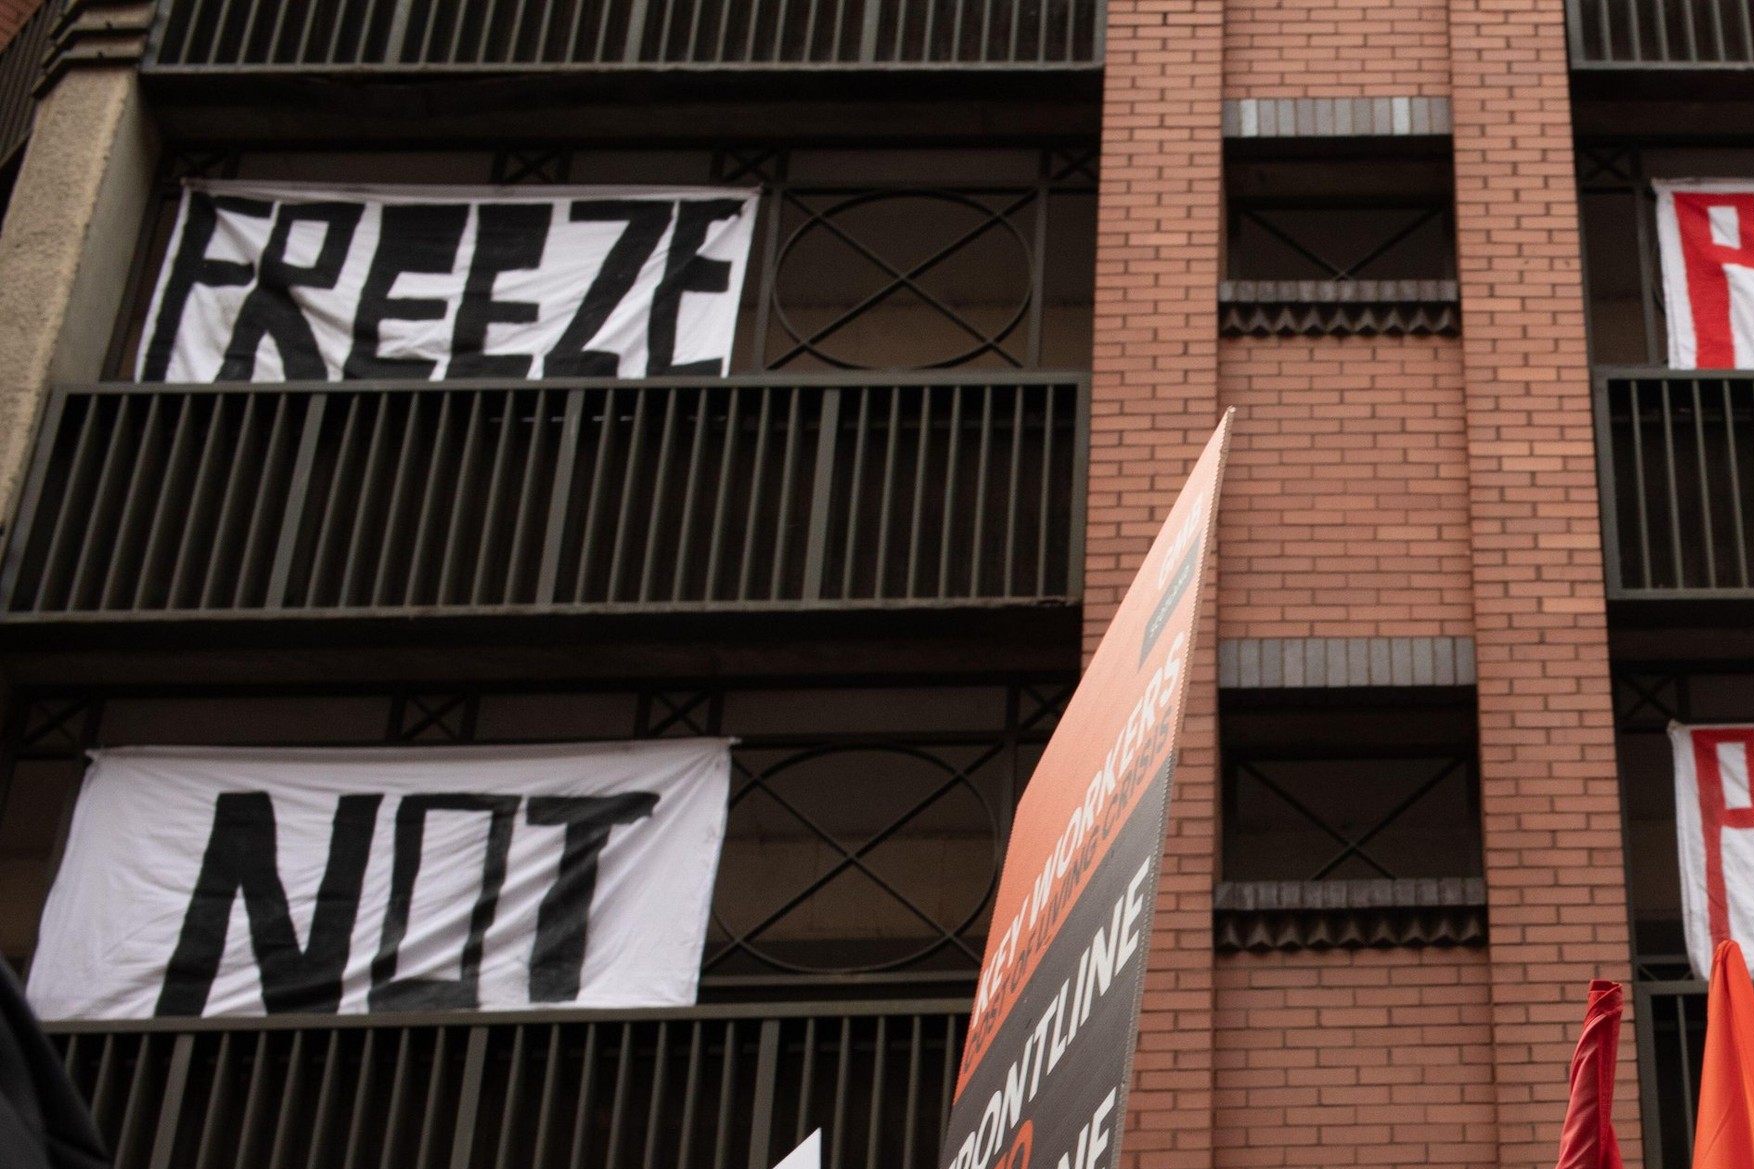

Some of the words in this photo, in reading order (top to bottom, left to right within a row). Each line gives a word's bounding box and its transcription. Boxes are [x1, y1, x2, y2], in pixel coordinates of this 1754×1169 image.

[143, 196, 744, 382] FREEZE
[1157, 493, 1203, 590] GMB
[154, 791, 660, 1018] NOT
[971, 894, 1031, 1029] KEY
[1028, 631, 1185, 930] WORKERS
[1037, 824, 1100, 952] LIVING
[1102, 705, 1172, 840] CRISIS
